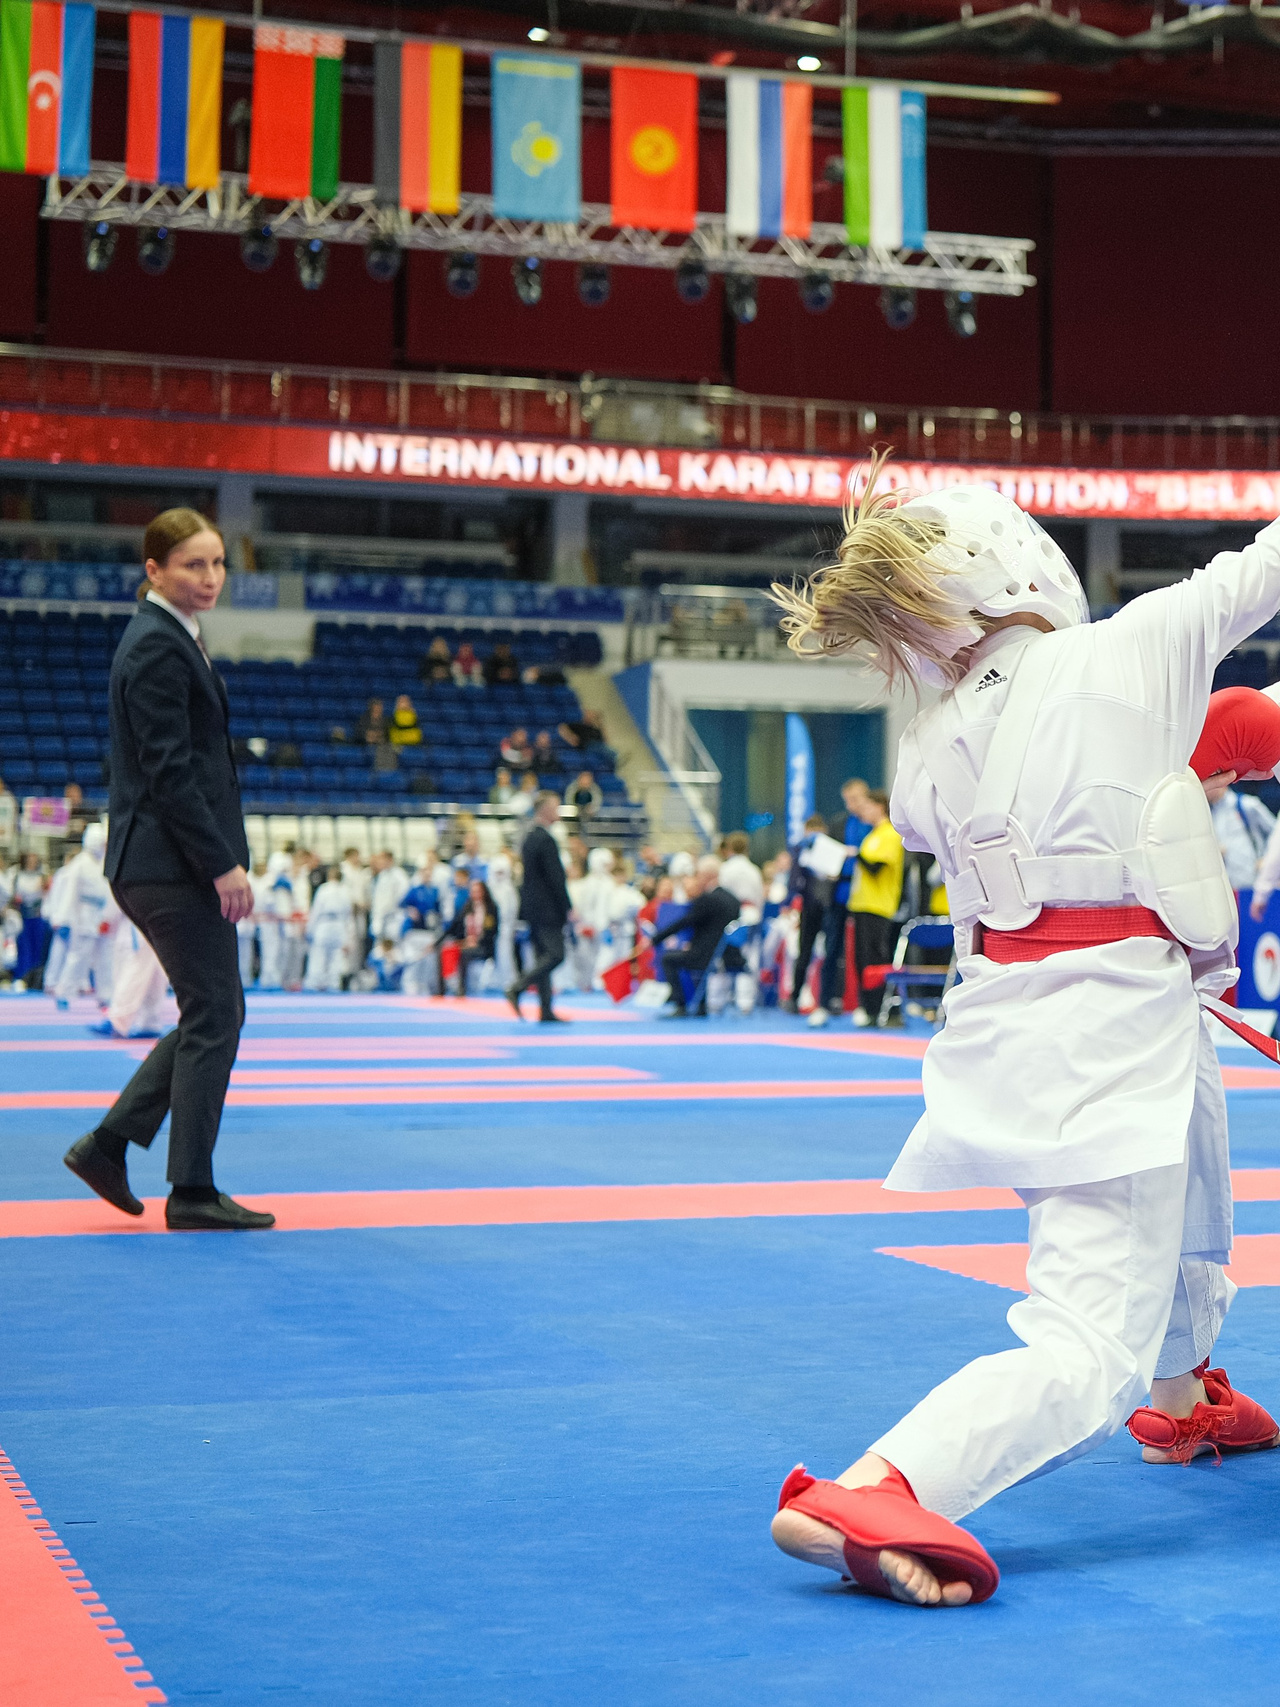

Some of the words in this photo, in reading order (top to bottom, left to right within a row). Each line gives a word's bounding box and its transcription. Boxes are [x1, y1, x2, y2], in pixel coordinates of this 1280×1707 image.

[329, 431, 673, 490] INTERNATIONAL
[679, 452, 841, 499] KARATE
[975, 675, 1007, 692] adidas
